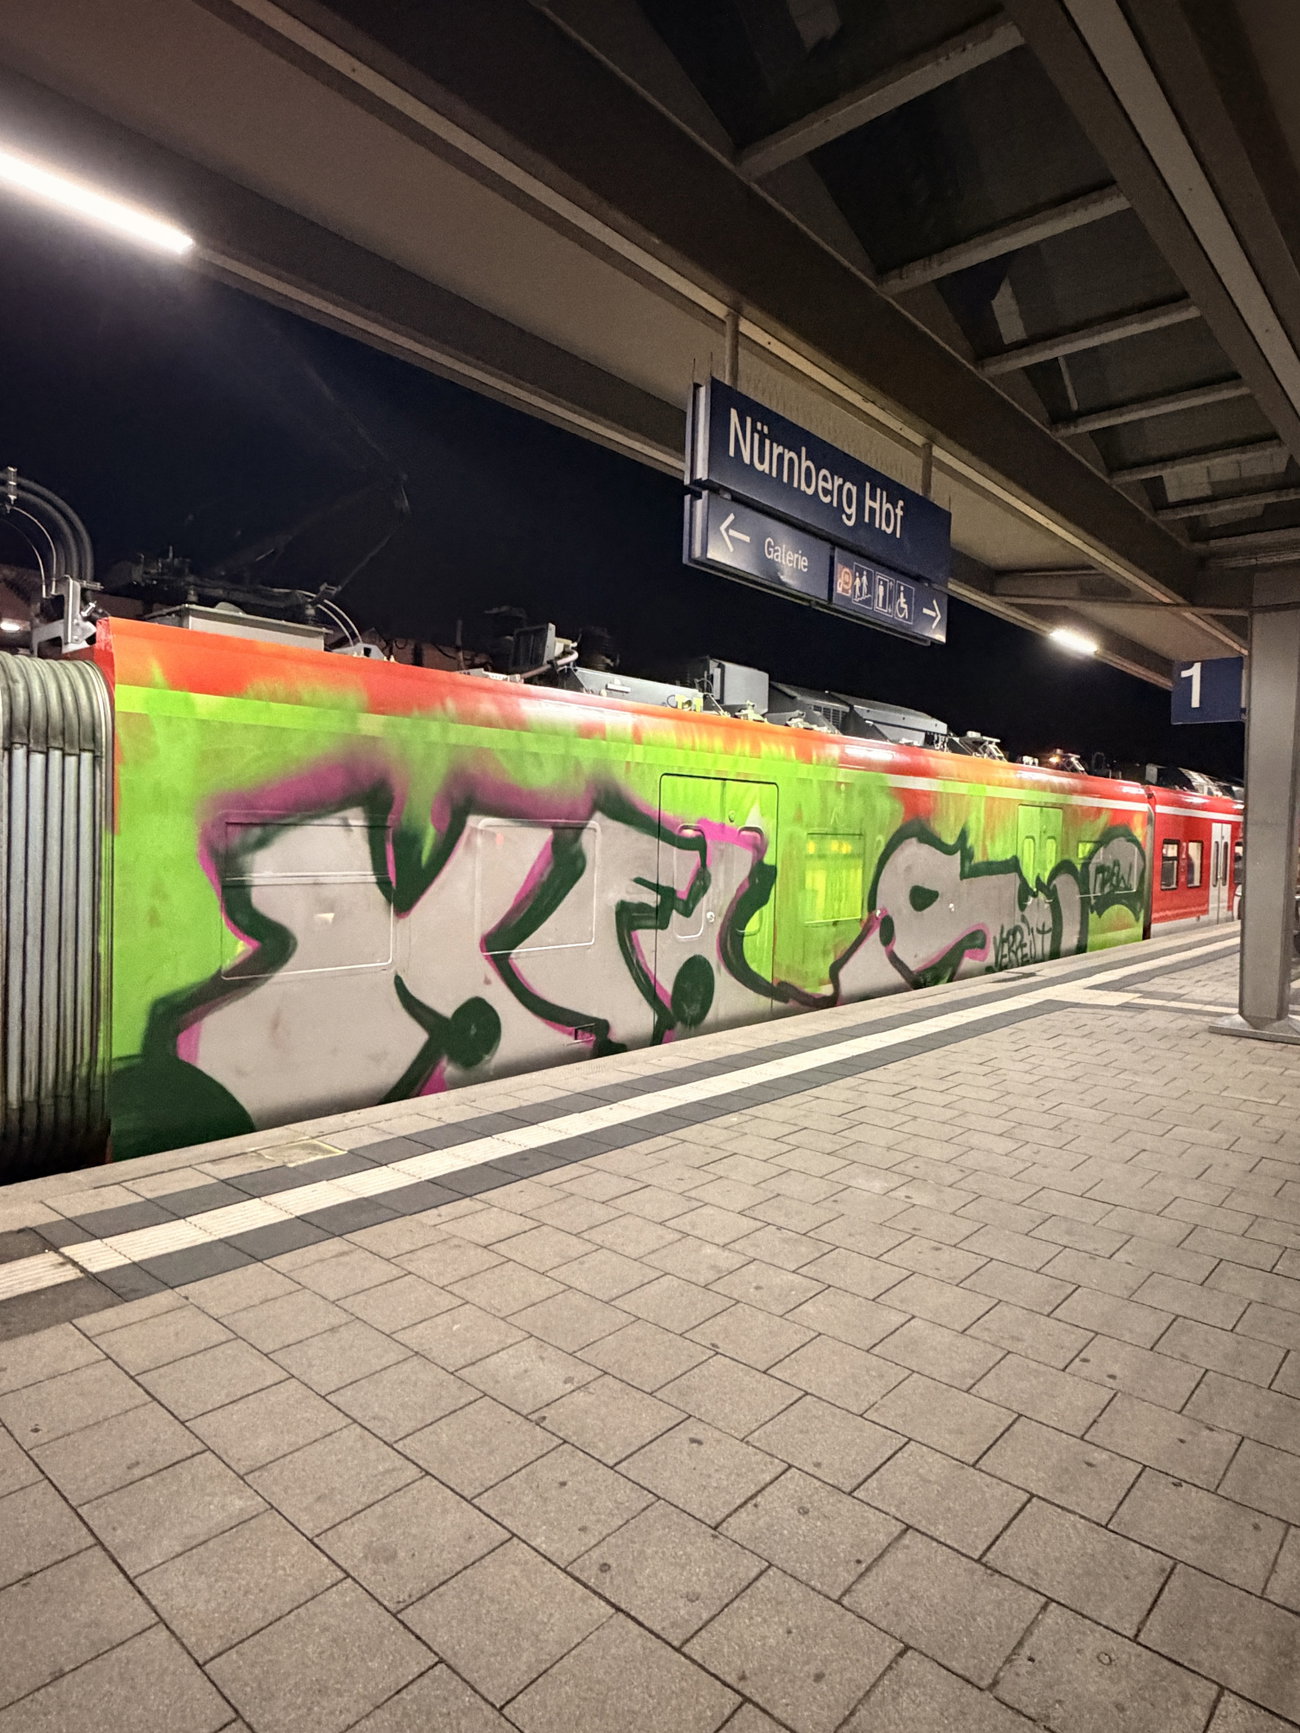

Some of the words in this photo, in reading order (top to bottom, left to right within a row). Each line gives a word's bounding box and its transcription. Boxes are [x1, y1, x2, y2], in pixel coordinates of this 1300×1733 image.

[728, 407, 858, 527] Nürnberg
[864, 481, 904, 539] Hbf
[764, 537, 809, 573] Galerie
[1180, 661, 1202, 708] 1
